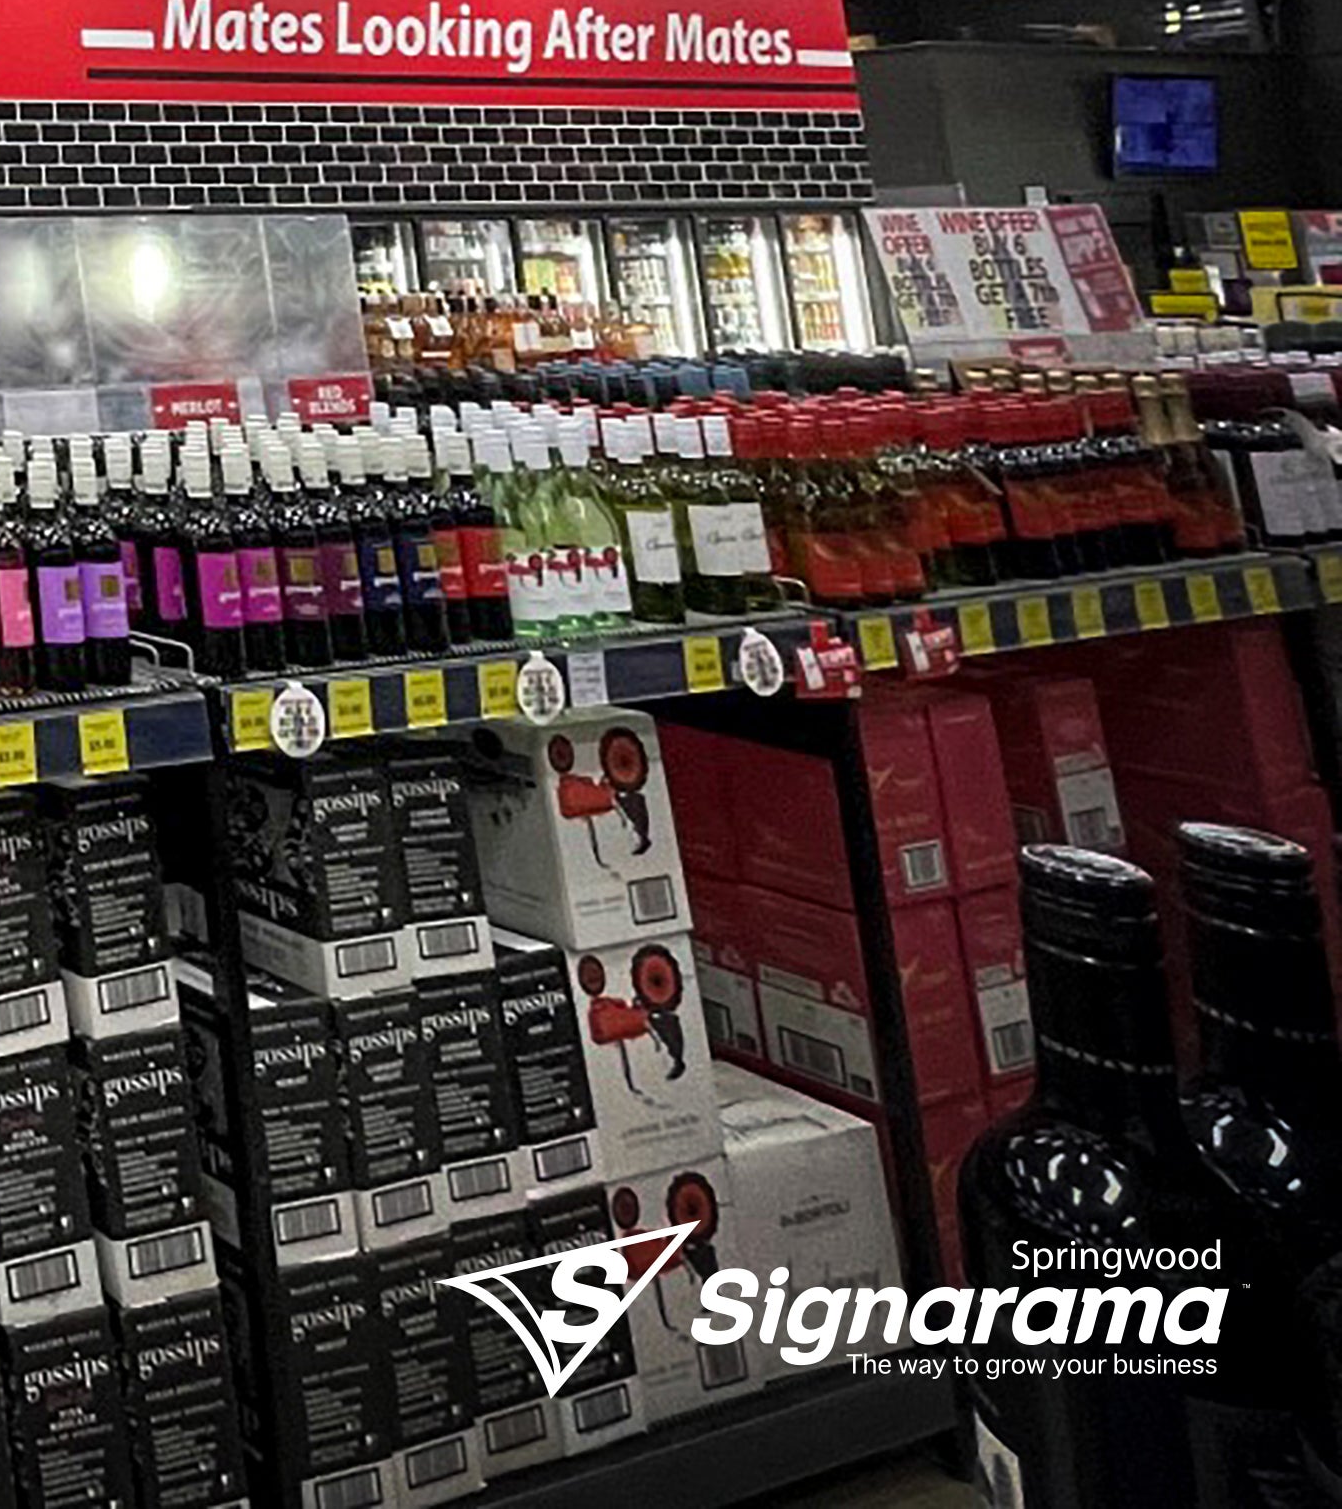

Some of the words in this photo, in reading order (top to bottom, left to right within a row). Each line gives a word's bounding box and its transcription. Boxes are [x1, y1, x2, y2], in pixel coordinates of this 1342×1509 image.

[336, 1, 534, 73] Looking
[544, 6, 656, 63] After
[665, 12, 794, 66] Mates
[878, 213, 922, 234] WINE
[936, 211, 985, 234] WINE
[986, 210, 1042, 233] OFFER
[883, 236, 935, 257] OFFER
[973, 235, 1008, 256] BUY
[1013, 233, 1027, 256] 6
[968, 257, 1049, 281] BOTTLES
[976, 283, 1008, 306] GET
[170, 398, 223, 417] MERLOT
[307, 399, 356, 415] BLENDS
[317, 385, 343, 400] RED
[313, 784, 383, 823] gossips
[390, 770, 462, 809] gossips
[76, 811, 151, 853] gossips
[420, 1001, 492, 1043] gossips
[502, 982, 568, 1025] gossips
[253, 1034, 327, 1078] gossips
[349, 1021, 418, 1063] gossips
[102, 1061, 185, 1108] gossips
[290, 1295, 366, 1343] gossips
[135, 1330, 222, 1380] gossips
[23, 1352, 111, 1402] gossips
